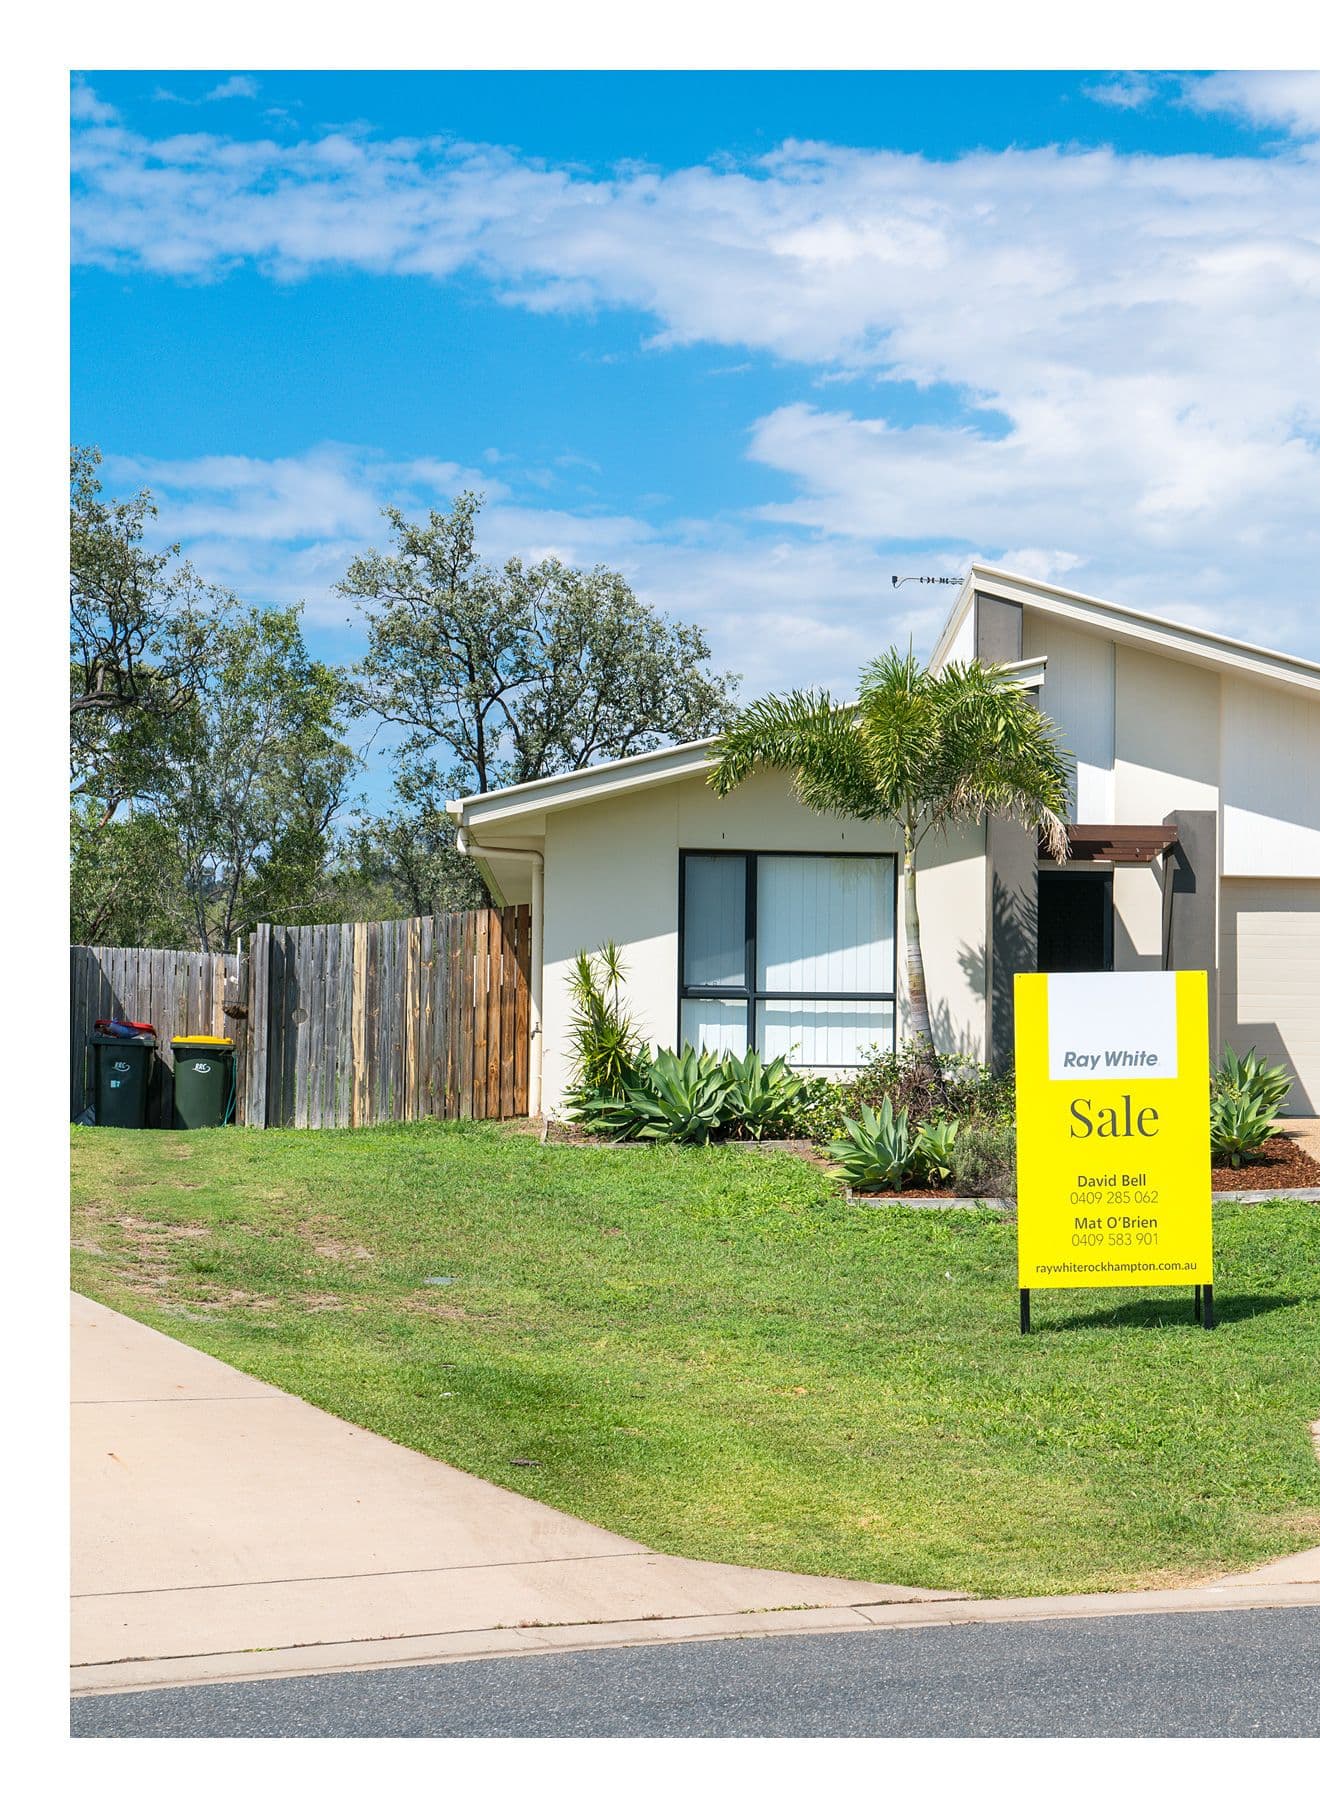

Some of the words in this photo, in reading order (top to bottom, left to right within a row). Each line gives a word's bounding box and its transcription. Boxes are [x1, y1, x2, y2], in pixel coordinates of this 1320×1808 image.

[1063, 1051, 1101, 1071] Ray
[1105, 1050, 1158, 1067] White
[1070, 1095, 1160, 1139] Sale
[1077, 1174, 1117, 1187] David
[1122, 1173, 1147, 1187] Bell
[1070, 1192, 1103, 1205] 0409
[1106, 1191, 1131, 1204] 285
[1134, 1190, 1159, 1204] 062
[1074, 1217, 1103, 1229] Mat
[1071, 1233, 1104, 1247] 0409
[1108, 1232, 1132, 1246] 583
[1135, 1232, 1158, 1246] 901
[1035, 1261, 1198, 1275] raywhiterockhampton.com.au
